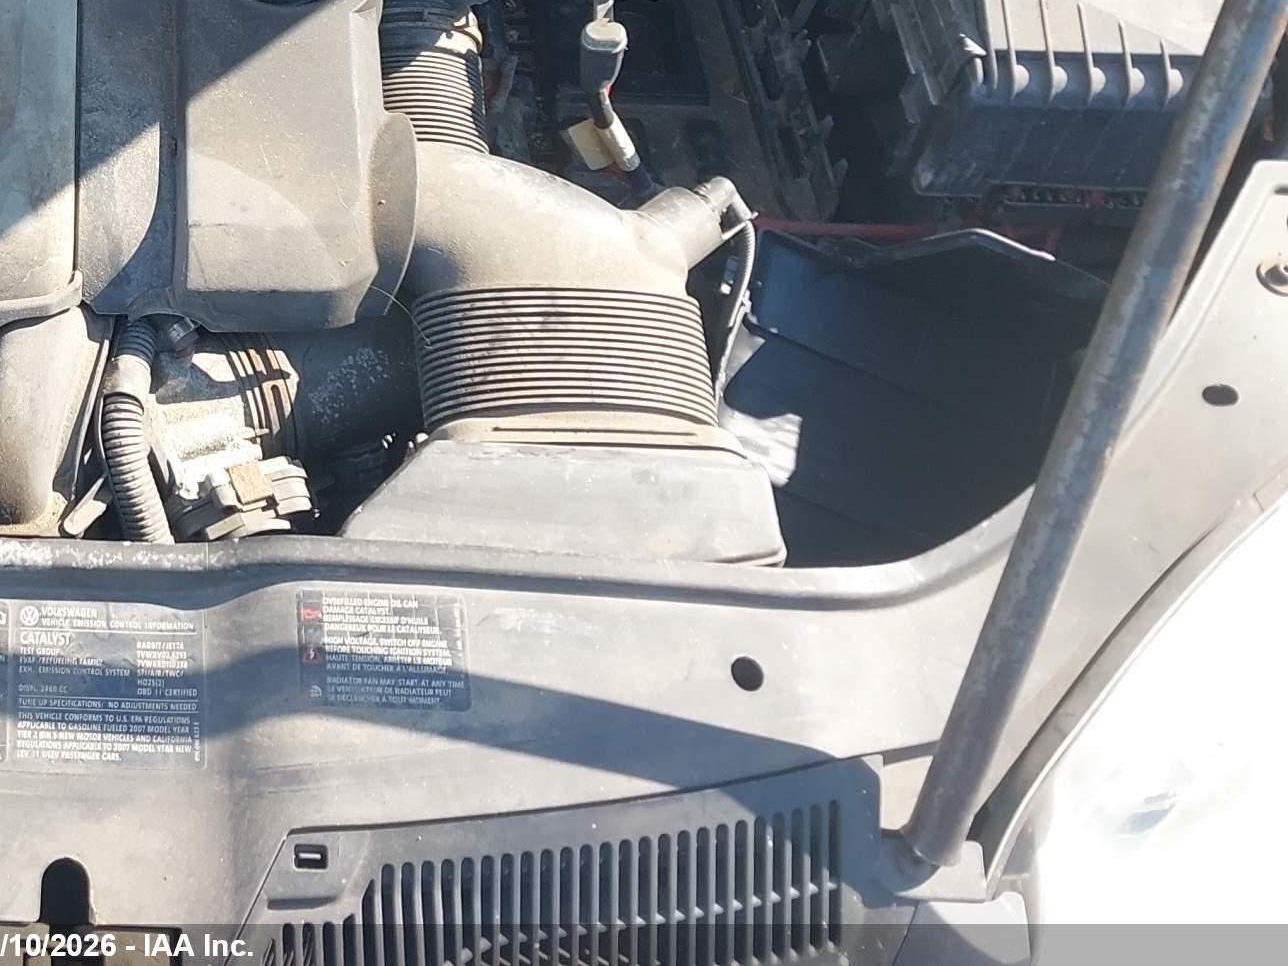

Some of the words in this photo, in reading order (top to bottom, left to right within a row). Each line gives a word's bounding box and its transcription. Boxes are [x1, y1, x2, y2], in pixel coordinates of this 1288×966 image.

[323, 597, 363, 606] OVERFILLED
[364, 599, 389, 607] ENGINE
[391, 600, 402, 608] OIL
[403, 600, 418, 608] CAN
[41, 606, 98, 618] VOLKSWAGEN
[323, 606, 354, 614] DAMAGE
[41, 618, 69, 628] VEHICLE
[72, 619, 107, 628] EMISSION
[110, 620, 142, 630] CONTROL
[144, 622, 194, 630] INFORMATION
[20, 631, 71, 646] CATALYST
[379, 638, 407, 646] SWITCH
[408, 639, 421, 647] OFF
[422, 640, 448, 648] ENGINE
[20, 646, 34, 655] TEST
[36, 647, 60, 656] GROUP
[325, 644, 350, 654] BEFORE
[352, 646, 388, 654] TOUCHING
[20, 656, 35, 664] EVAP
[326, 654, 348, 662] HAUTE
[422, 657, 452, 666] MOTEUR
[38, 666, 70, 675] EMISSION
[73, 666, 104, 676] CONTROL
[105, 668, 130, 676] SYSTEM
[326, 662, 350, 670] AVANT
[362, 664, 394, 672] TOUCHER
[326, 676, 362, 684] RADIATOR
[364, 677, 378, 685] FAN
[380, 678, 395, 686] MAY
[398, 678, 418, 686] START
[432, 680, 446, 688] ANY
[138, 688, 152, 696] OBD
[165, 688, 198, 697] CERTIFIED
[394, 687, 434, 696] RADIATEUR
[435, 688, 452, 696] PEUT
[18, 698, 36, 706] TUNE
[38, 698, 48, 706] UP
[108, 701, 120, 709] NO
[120, 702, 168, 710] ADJUSTMENTS
[170, 702, 198, 711] NEEDED
[388, 696, 407, 704] TOUT
[18, 712, 34, 720] THIS
[35, 712, 62, 722] VEHICLE
[64, 713, 103, 722] CONFORMS
[104, 714, 114, 722] TO
[130, 715, 144, 724] EPA
[144, 716, 190, 724] REGULATIONS
[18, 721, 56, 730] APPLICABLE
[57, 722, 67, 730] TO
[68, 722, 101, 732] GASOLINE
[130, 724, 146, 733] 2007
[147, 725, 171, 734] MODEL
[172, 726, 190, 734] YEAR
[18, 730, 32, 739] TIER
[58, 732, 76, 740] NEW
[78, 732, 102, 742] MOTOR
[102, 733, 134, 742] VEHICLES
[136, 734, 152, 742] AND
[152, 734, 192, 744] CALIFORNIA
[17, 738, 62, 748] REGULATIONS
[62, 740, 102, 750] APPLICABLE
[103, 742, 113, 751] TO
[131, 743, 156, 752] MODEL
[156, 744, 174, 753] YEAR
[175, 744, 192, 754] NEW
[17, 748, 30, 758] LEV
[60, 750, 100, 760] PASSENGER
[102, 752, 122, 762] CARS.
